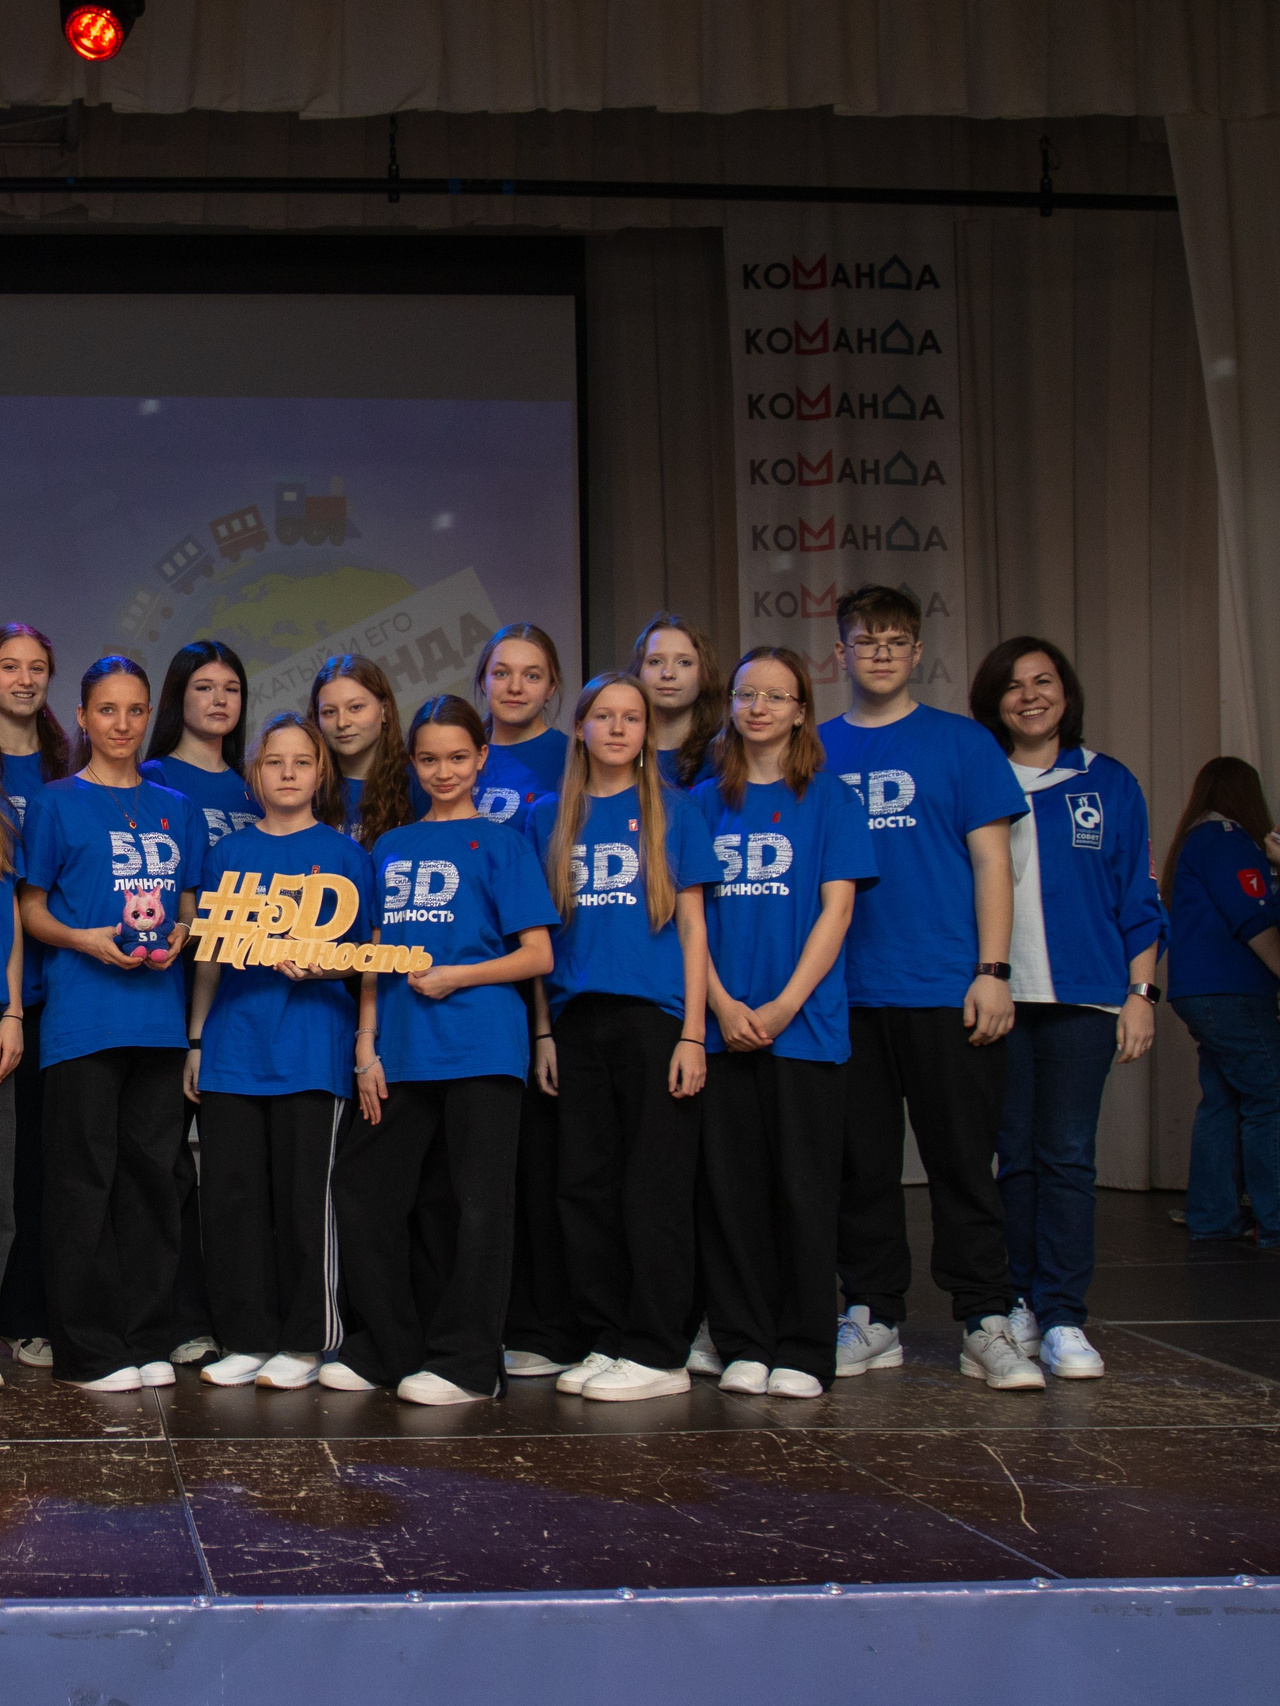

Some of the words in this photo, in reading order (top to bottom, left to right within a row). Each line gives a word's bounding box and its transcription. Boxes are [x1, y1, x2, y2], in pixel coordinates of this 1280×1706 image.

[743, 253, 941, 291] КОМАНДА
[745, 318, 942, 356] КОМАНДА
[747, 383, 945, 421] КОМАНДА
[750, 449, 947, 487] КОМАНДА
[752, 515, 949, 552] КОМАНДА
[365, 611, 413, 648] ЕГО
[109, 831, 181, 877] 5D
[713, 833, 793, 883] 5D
[384, 860, 460, 909] 5D
[714, 882, 790, 898] ЛИЧНОСТЬ
[232, 928, 434, 974] Личность
